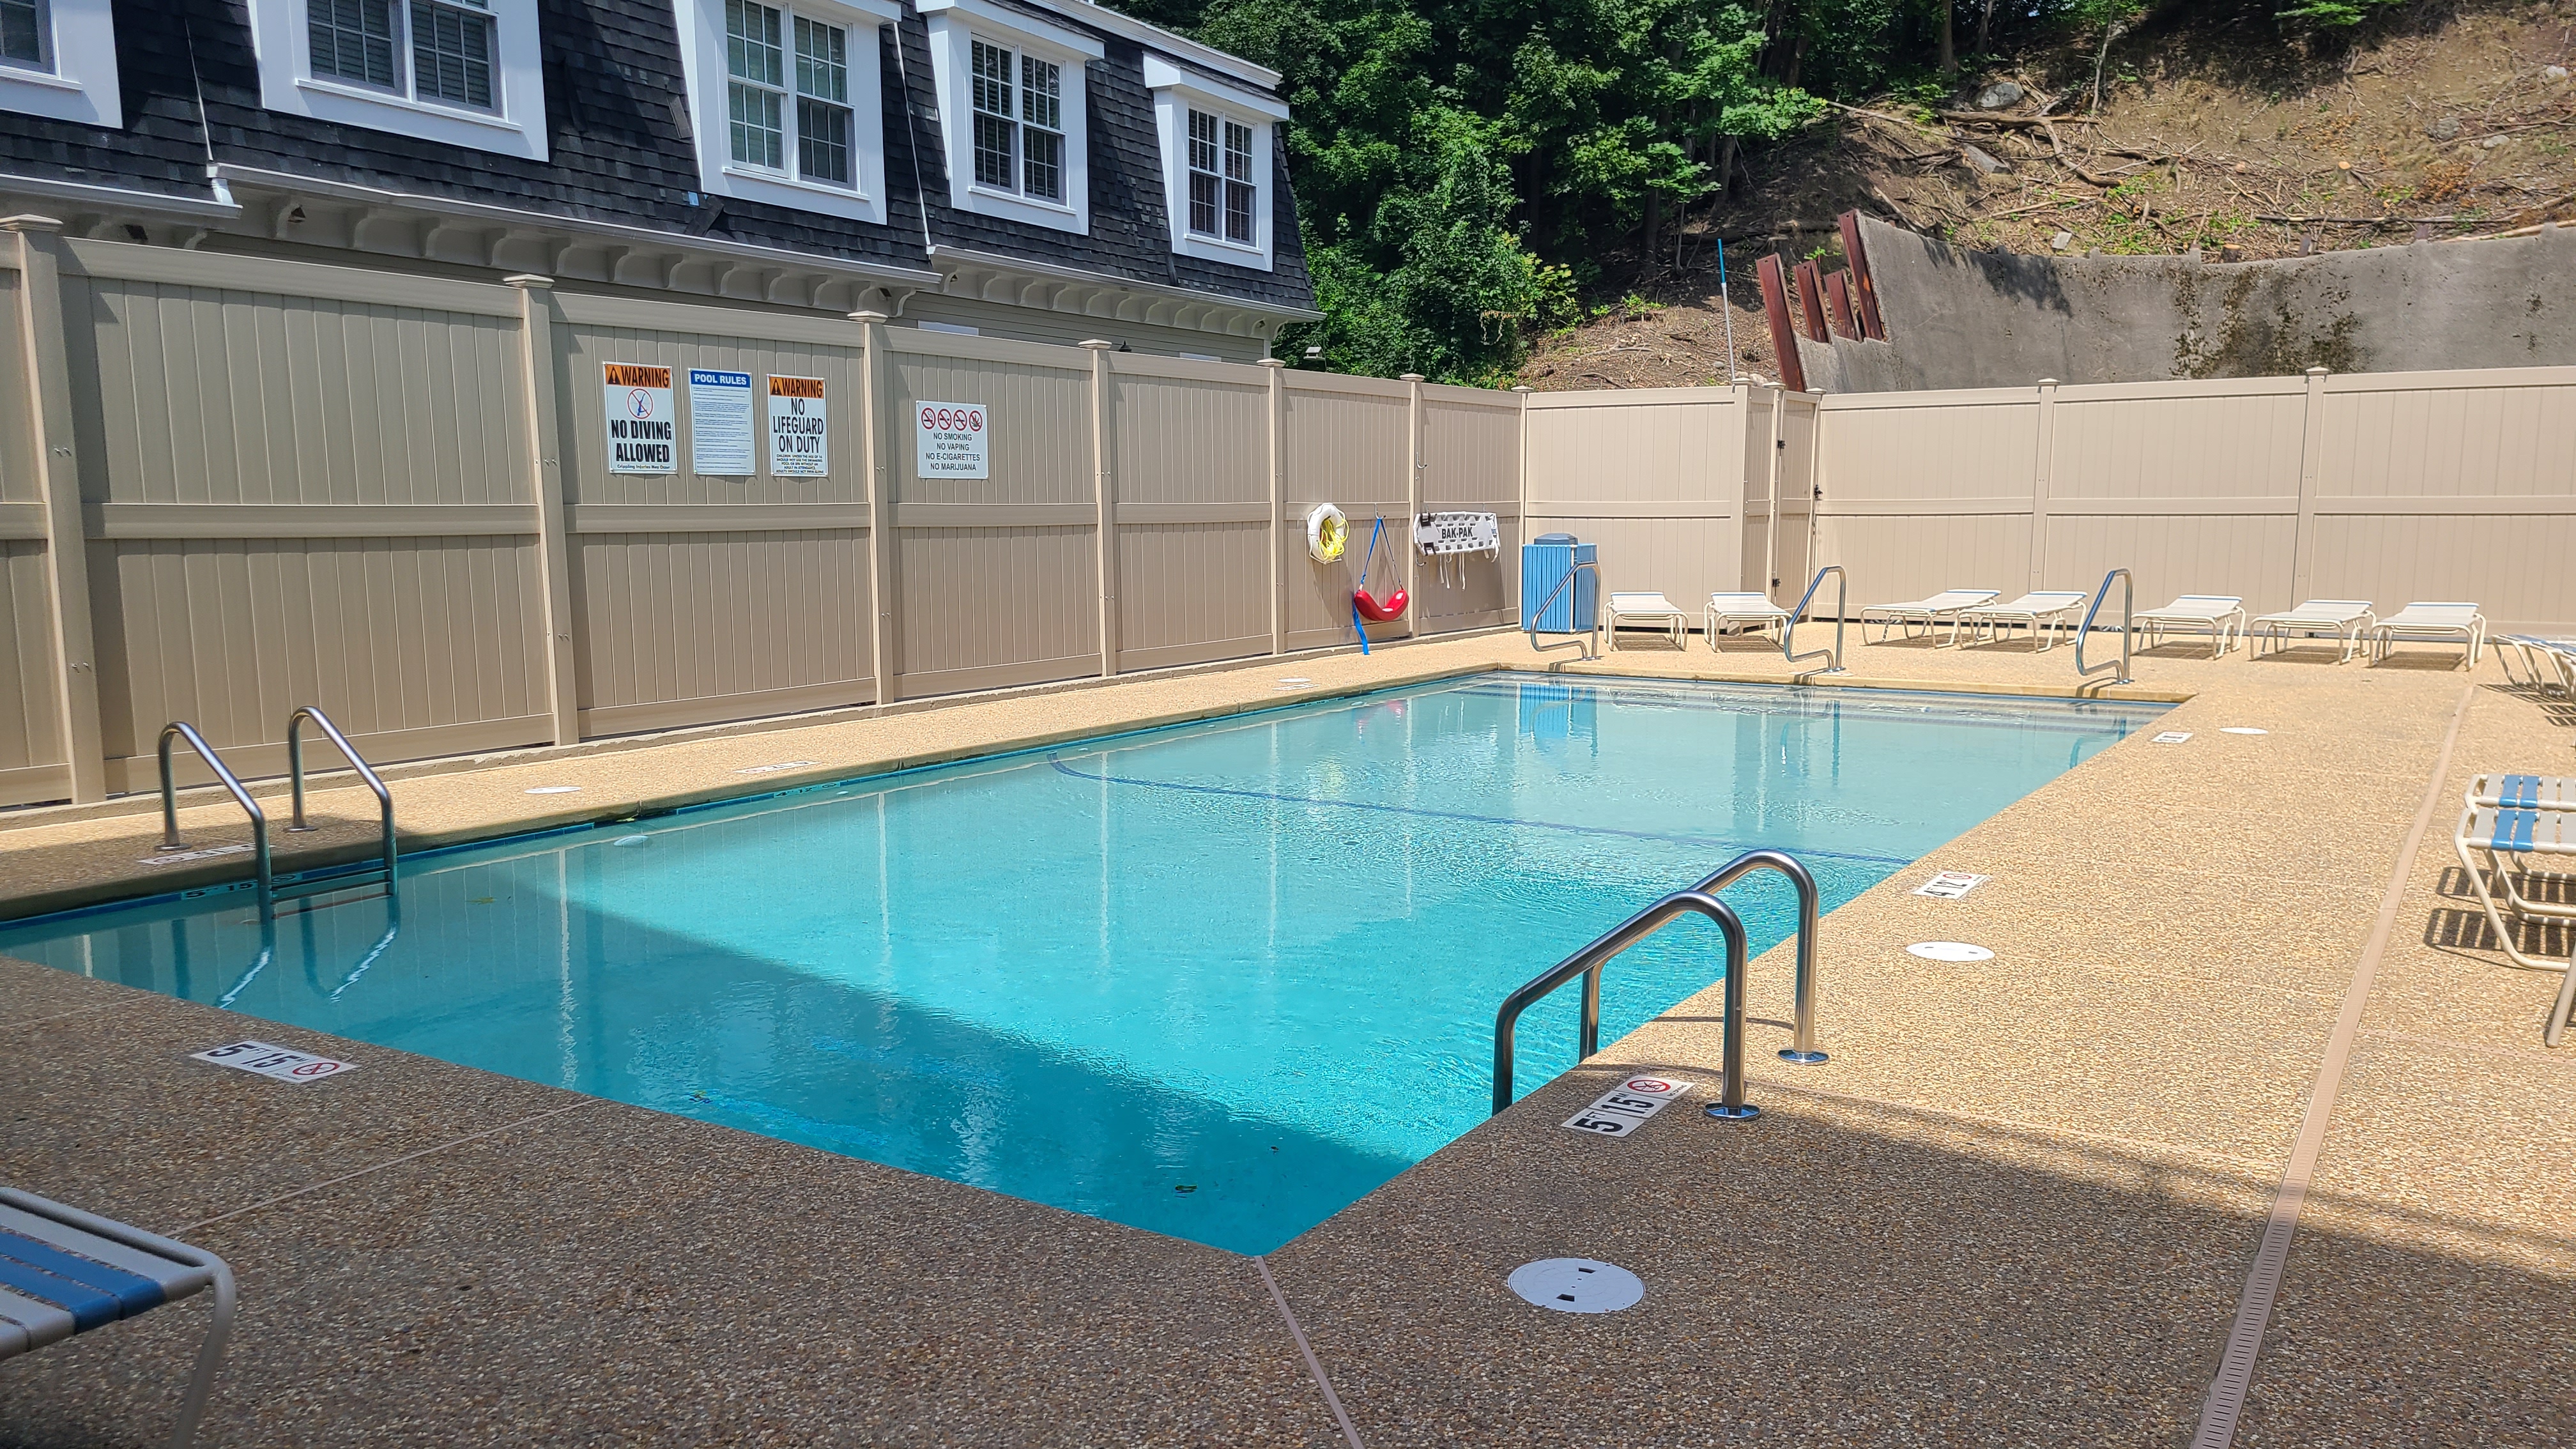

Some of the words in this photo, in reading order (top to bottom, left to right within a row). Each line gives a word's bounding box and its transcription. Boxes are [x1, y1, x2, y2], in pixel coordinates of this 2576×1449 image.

[621, 366, 669, 388] WARNING
[694, 374, 717, 383] POOL
[719, 375, 747, 385] RULES
[781, 378, 822, 398] WARNING
[791, 397, 805, 415] NO
[611, 419, 627, 439] NO
[631, 420, 672, 441] DIVING
[773, 415, 824, 434] LIFEGUARD
[779, 434, 793, 452] ON
[796, 435, 820, 454] DUTY
[944, 433, 972, 441] SMOKING
[616, 443, 670, 463] ALLOWED
[947, 443, 970, 451] VAPING
[937, 452, 981, 461] E-CIGARETTES
[941, 463, 977, 471] MARIJUANA
[206, 1043, 257, 1057] 5
[1572, 1117, 1623, 1133] 5
